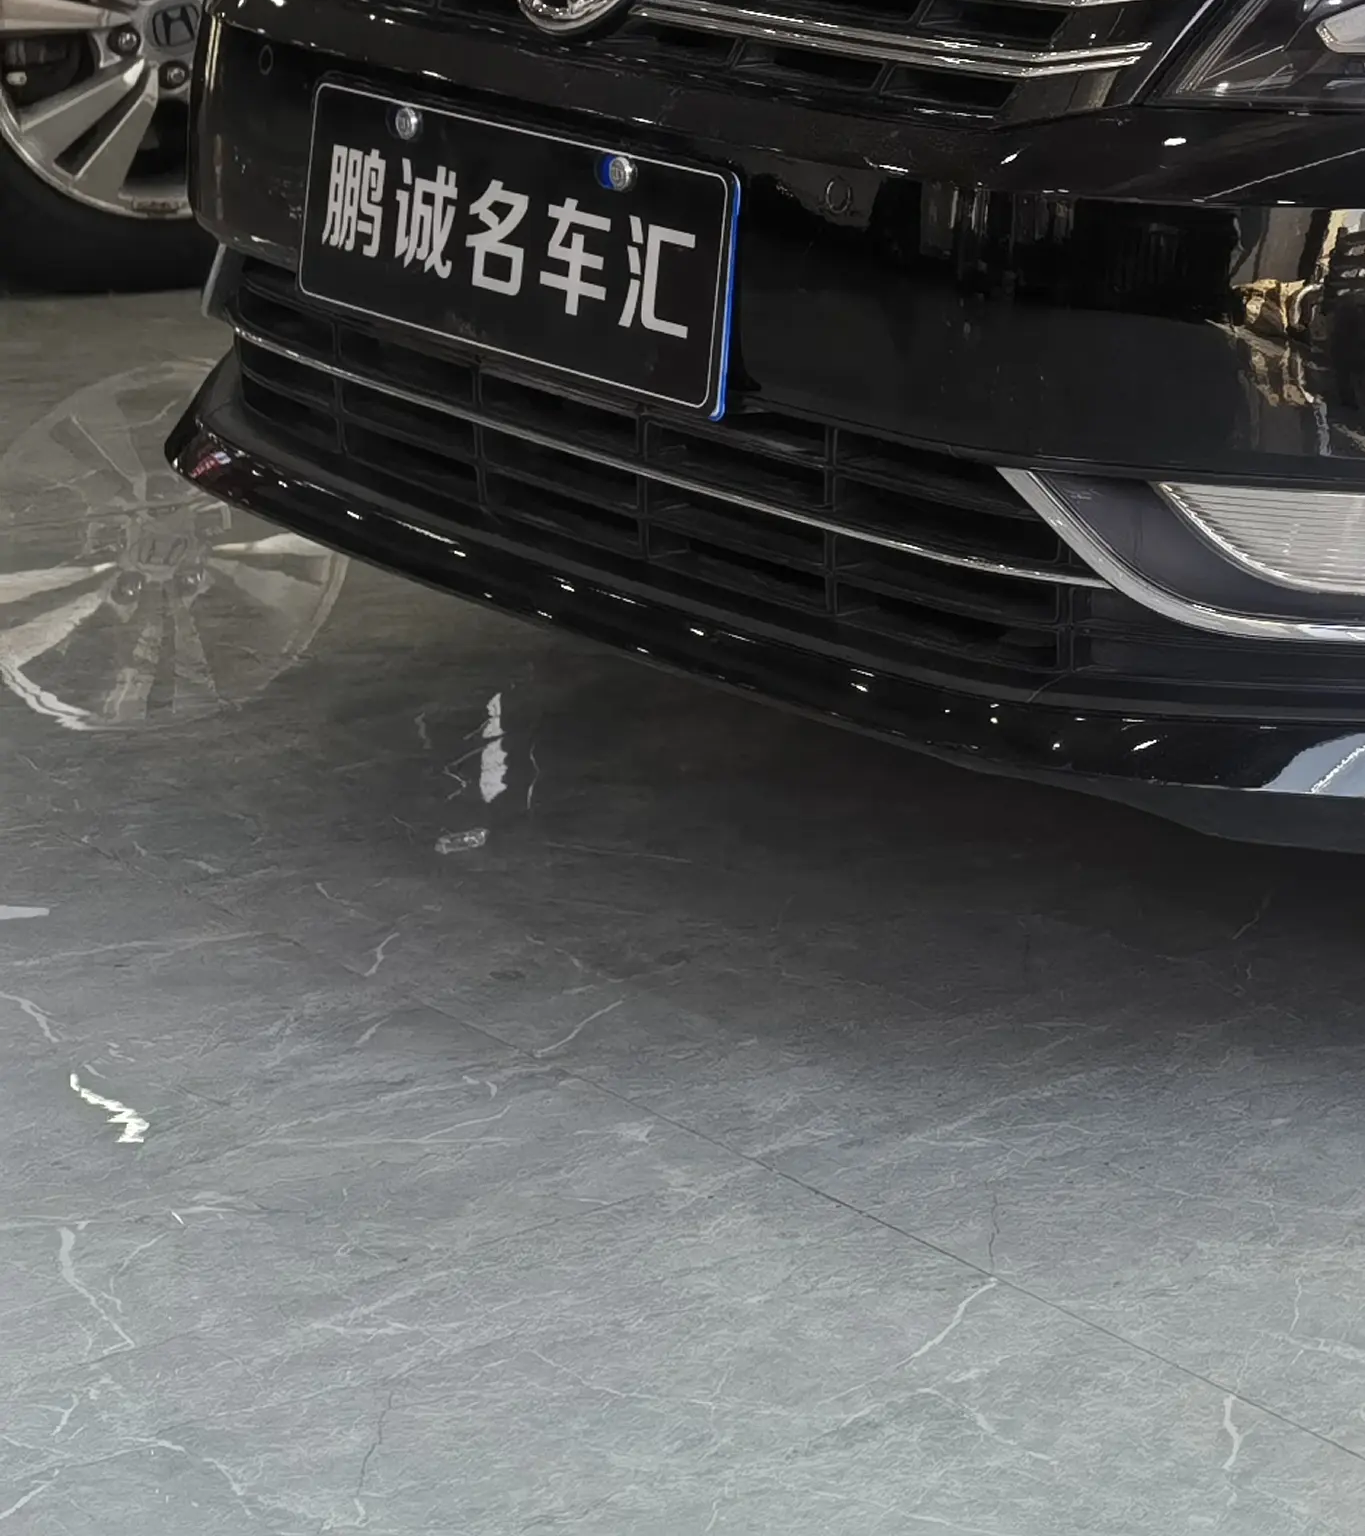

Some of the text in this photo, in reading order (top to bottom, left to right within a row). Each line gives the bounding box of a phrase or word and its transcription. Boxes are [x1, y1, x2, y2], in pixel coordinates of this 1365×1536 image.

[321, 144, 696, 339] 鹏诚名车汇
